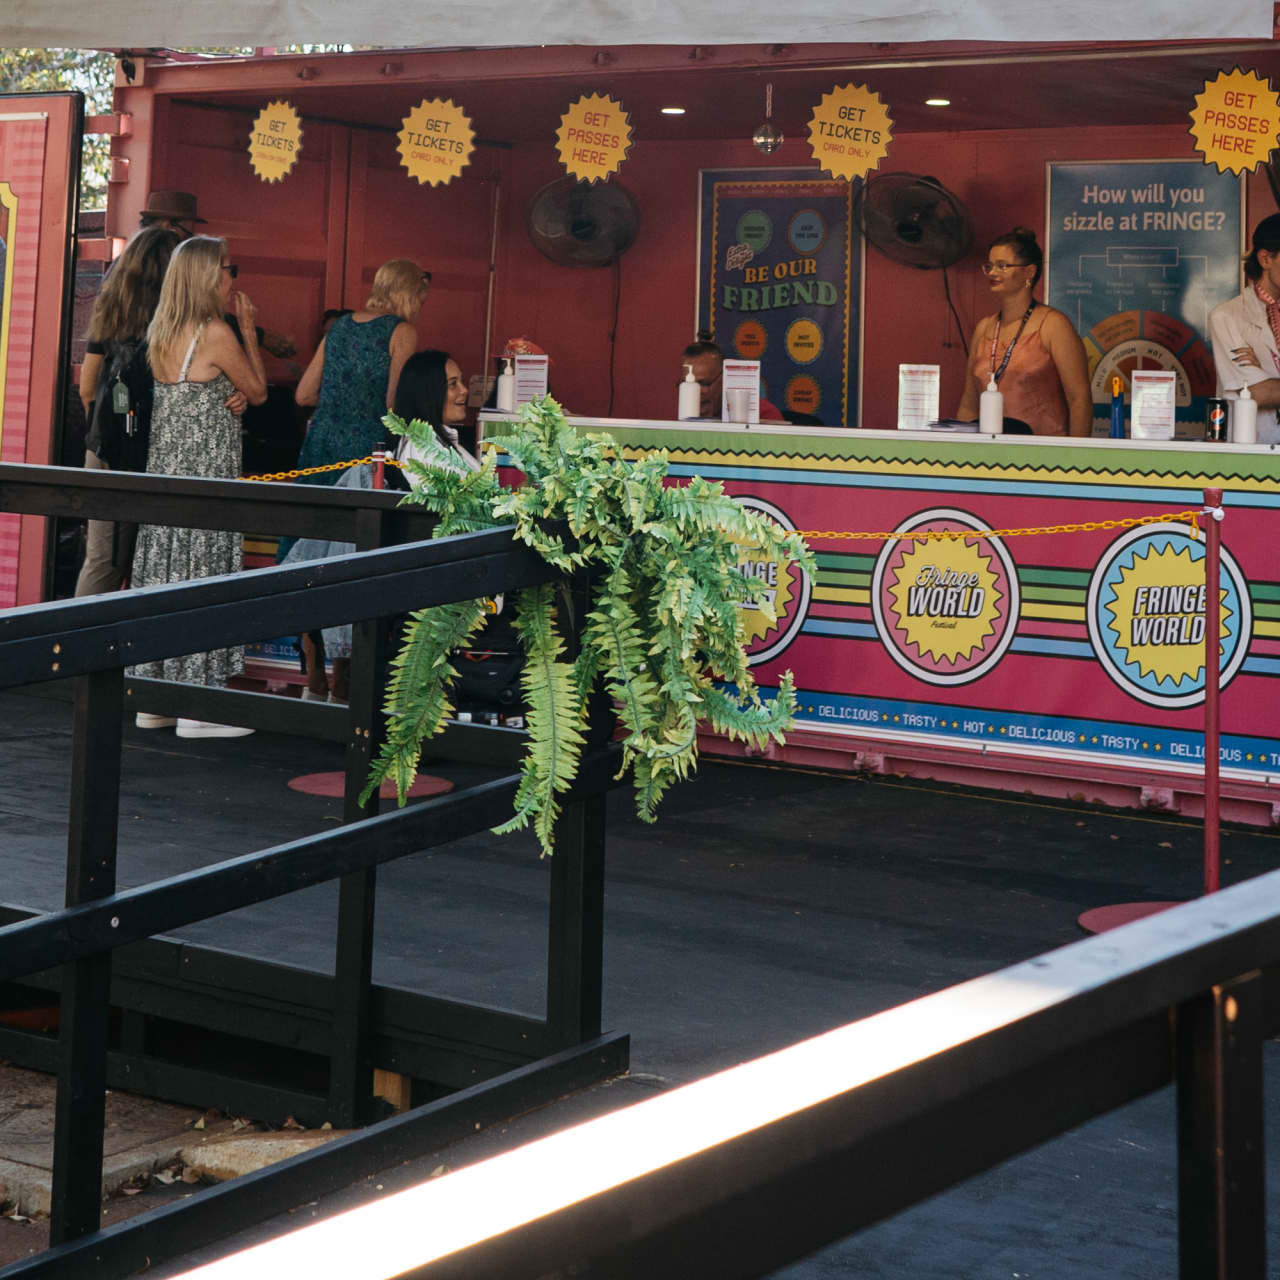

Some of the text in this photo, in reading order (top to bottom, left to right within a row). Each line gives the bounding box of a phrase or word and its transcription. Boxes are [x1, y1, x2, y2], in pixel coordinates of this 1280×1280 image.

[1224, 91, 1257, 110] GET
[584, 111, 611, 128] GET
[838, 106, 867, 122] GET
[1204, 110, 1270, 135] PASSES
[269, 120, 287, 134] GET
[426, 118, 451, 134] GET
[819, 121, 881, 145] TICKETS
[256, 132, 295, 153] TICKETS
[407, 131, 465, 155] TICKETS
[567, 127, 620, 149] PASSES
[1212, 133, 1256, 155] HERE
[572, 147, 608, 167] HERE
[1083, 184, 1205, 207] How will you
[1063, 211, 1226, 232] sizzle at FRINGE?
[744, 258, 817, 284] BE OUR
[721, 280, 838, 312] FRIEND
[916, 564, 979, 595] Fringe
[907, 585, 986, 619] WORLD
[1134, 584, 1206, 616] FRINGE
[1131, 616, 1206, 647] WORLD
[818, 704, 880, 722] DELICIOUS
[902, 713, 939, 729] TASTY
[963, 720, 985, 734] HOT
[1008, 725, 1076, 744] DELICIOUS
[1102, 734, 1140, 751] TASTY
